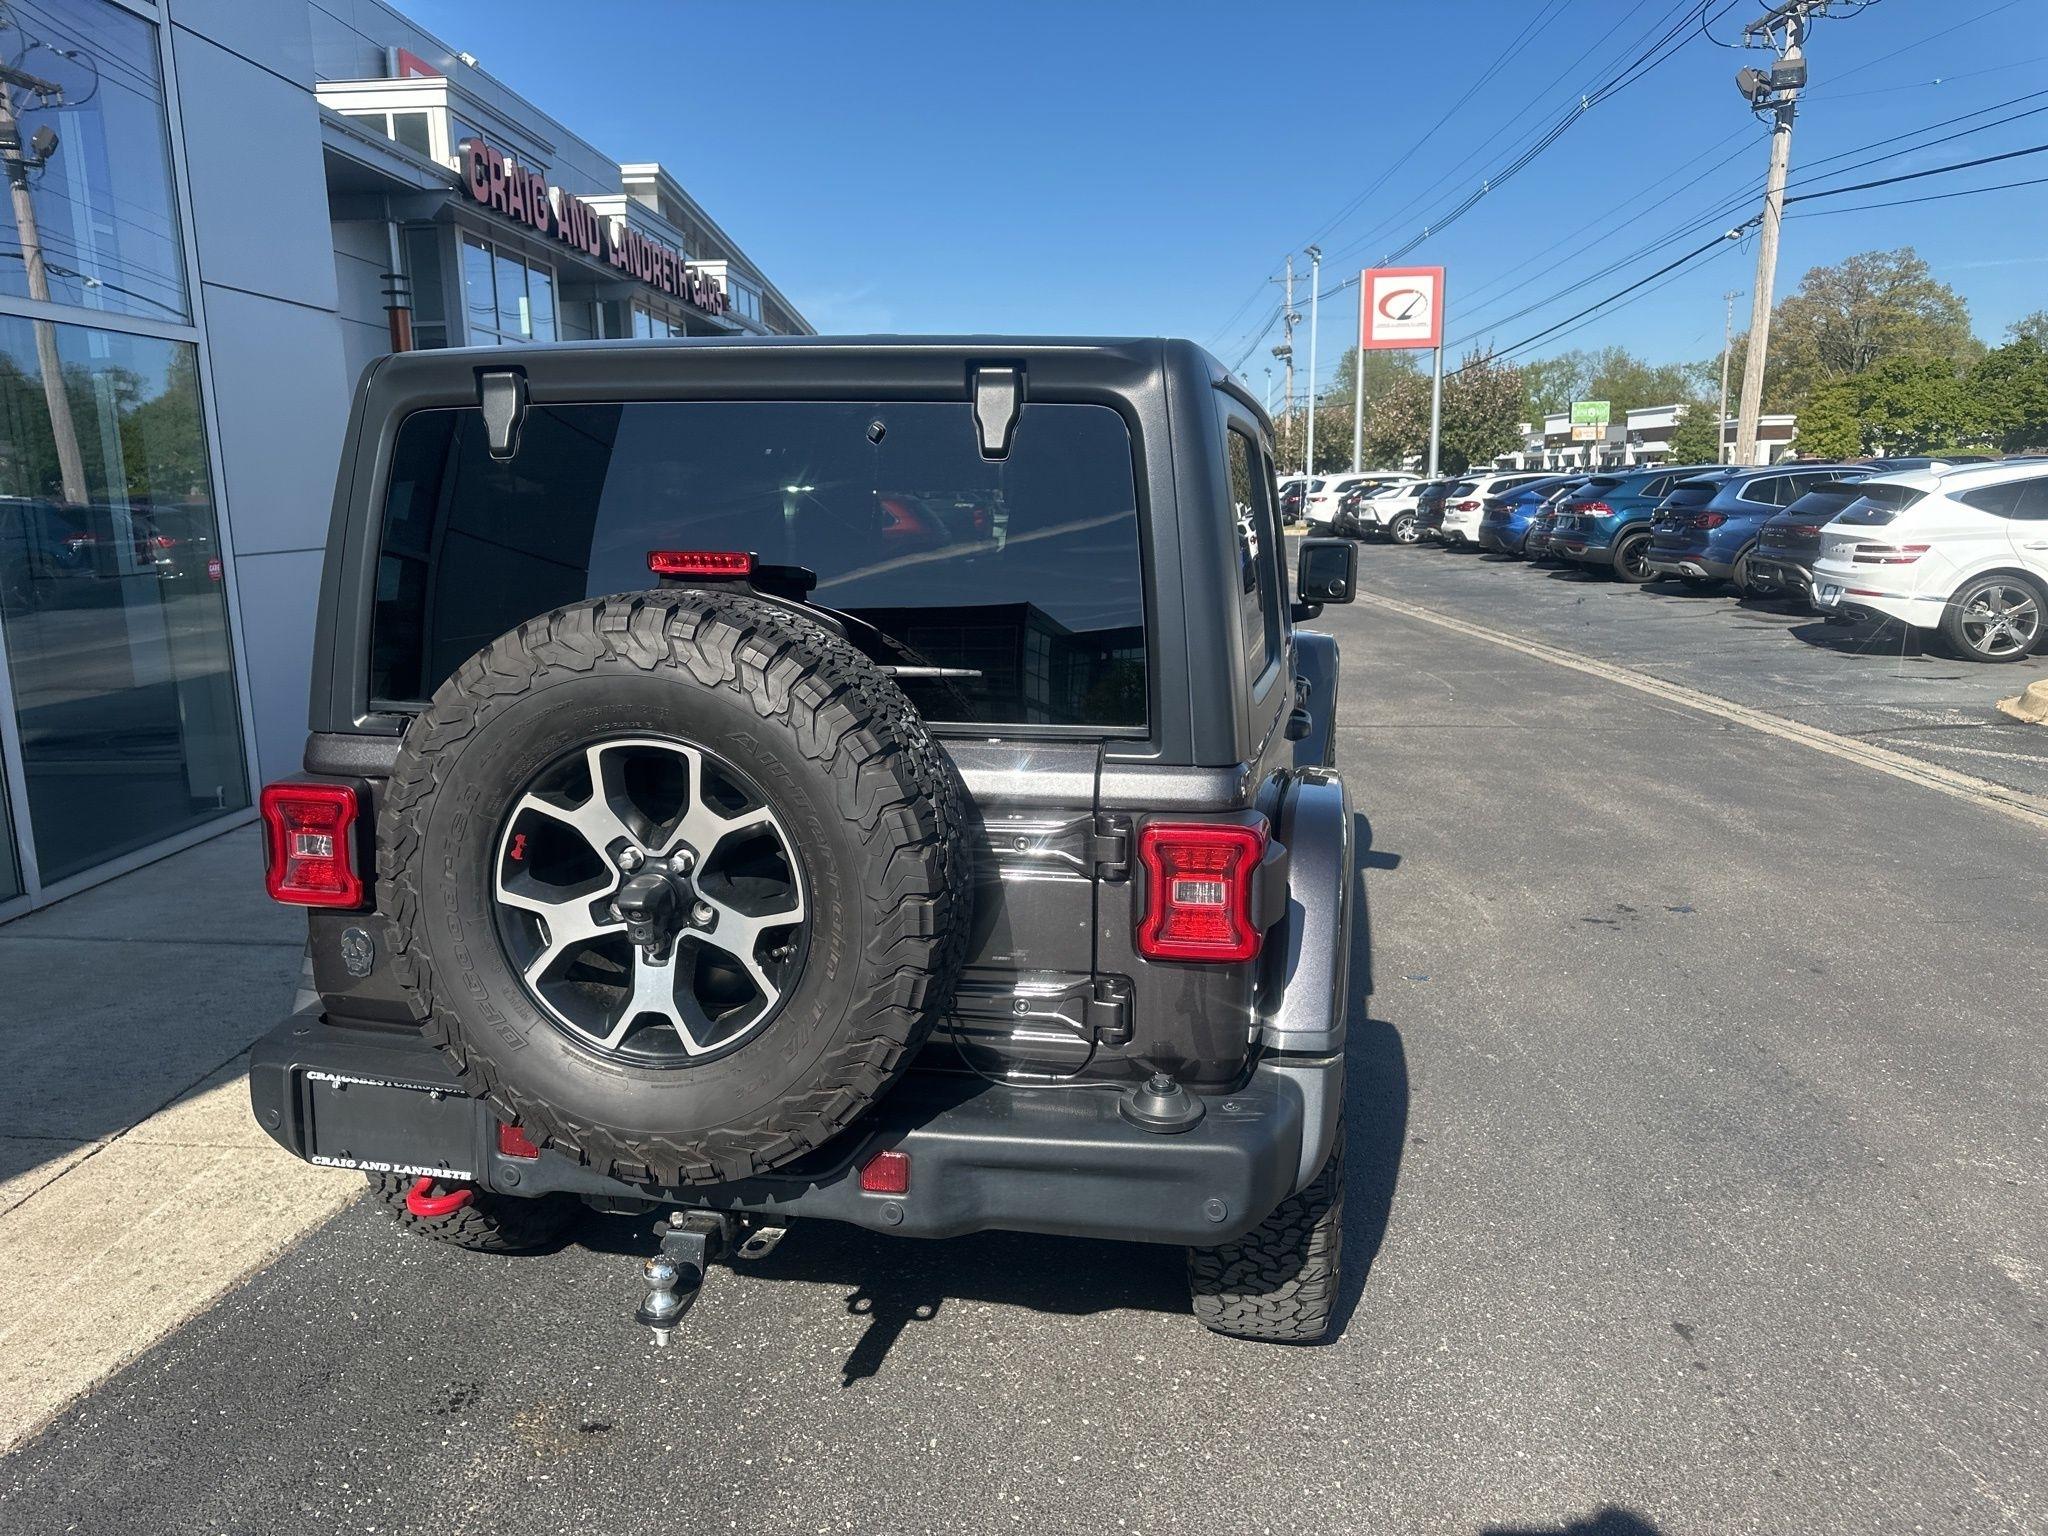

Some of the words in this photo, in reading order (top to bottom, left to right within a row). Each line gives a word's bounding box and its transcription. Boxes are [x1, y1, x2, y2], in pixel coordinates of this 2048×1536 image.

[464, 137, 549, 231] CRAIG
[557, 187, 600, 256] AND
[608, 216, 688, 299] LANDRETH
[691, 265, 723, 316] CARS
[312, 1156, 356, 1169] CRAIG
[359, 1161, 390, 1172] AND
[393, 1164, 471, 1181] LANDRETH
